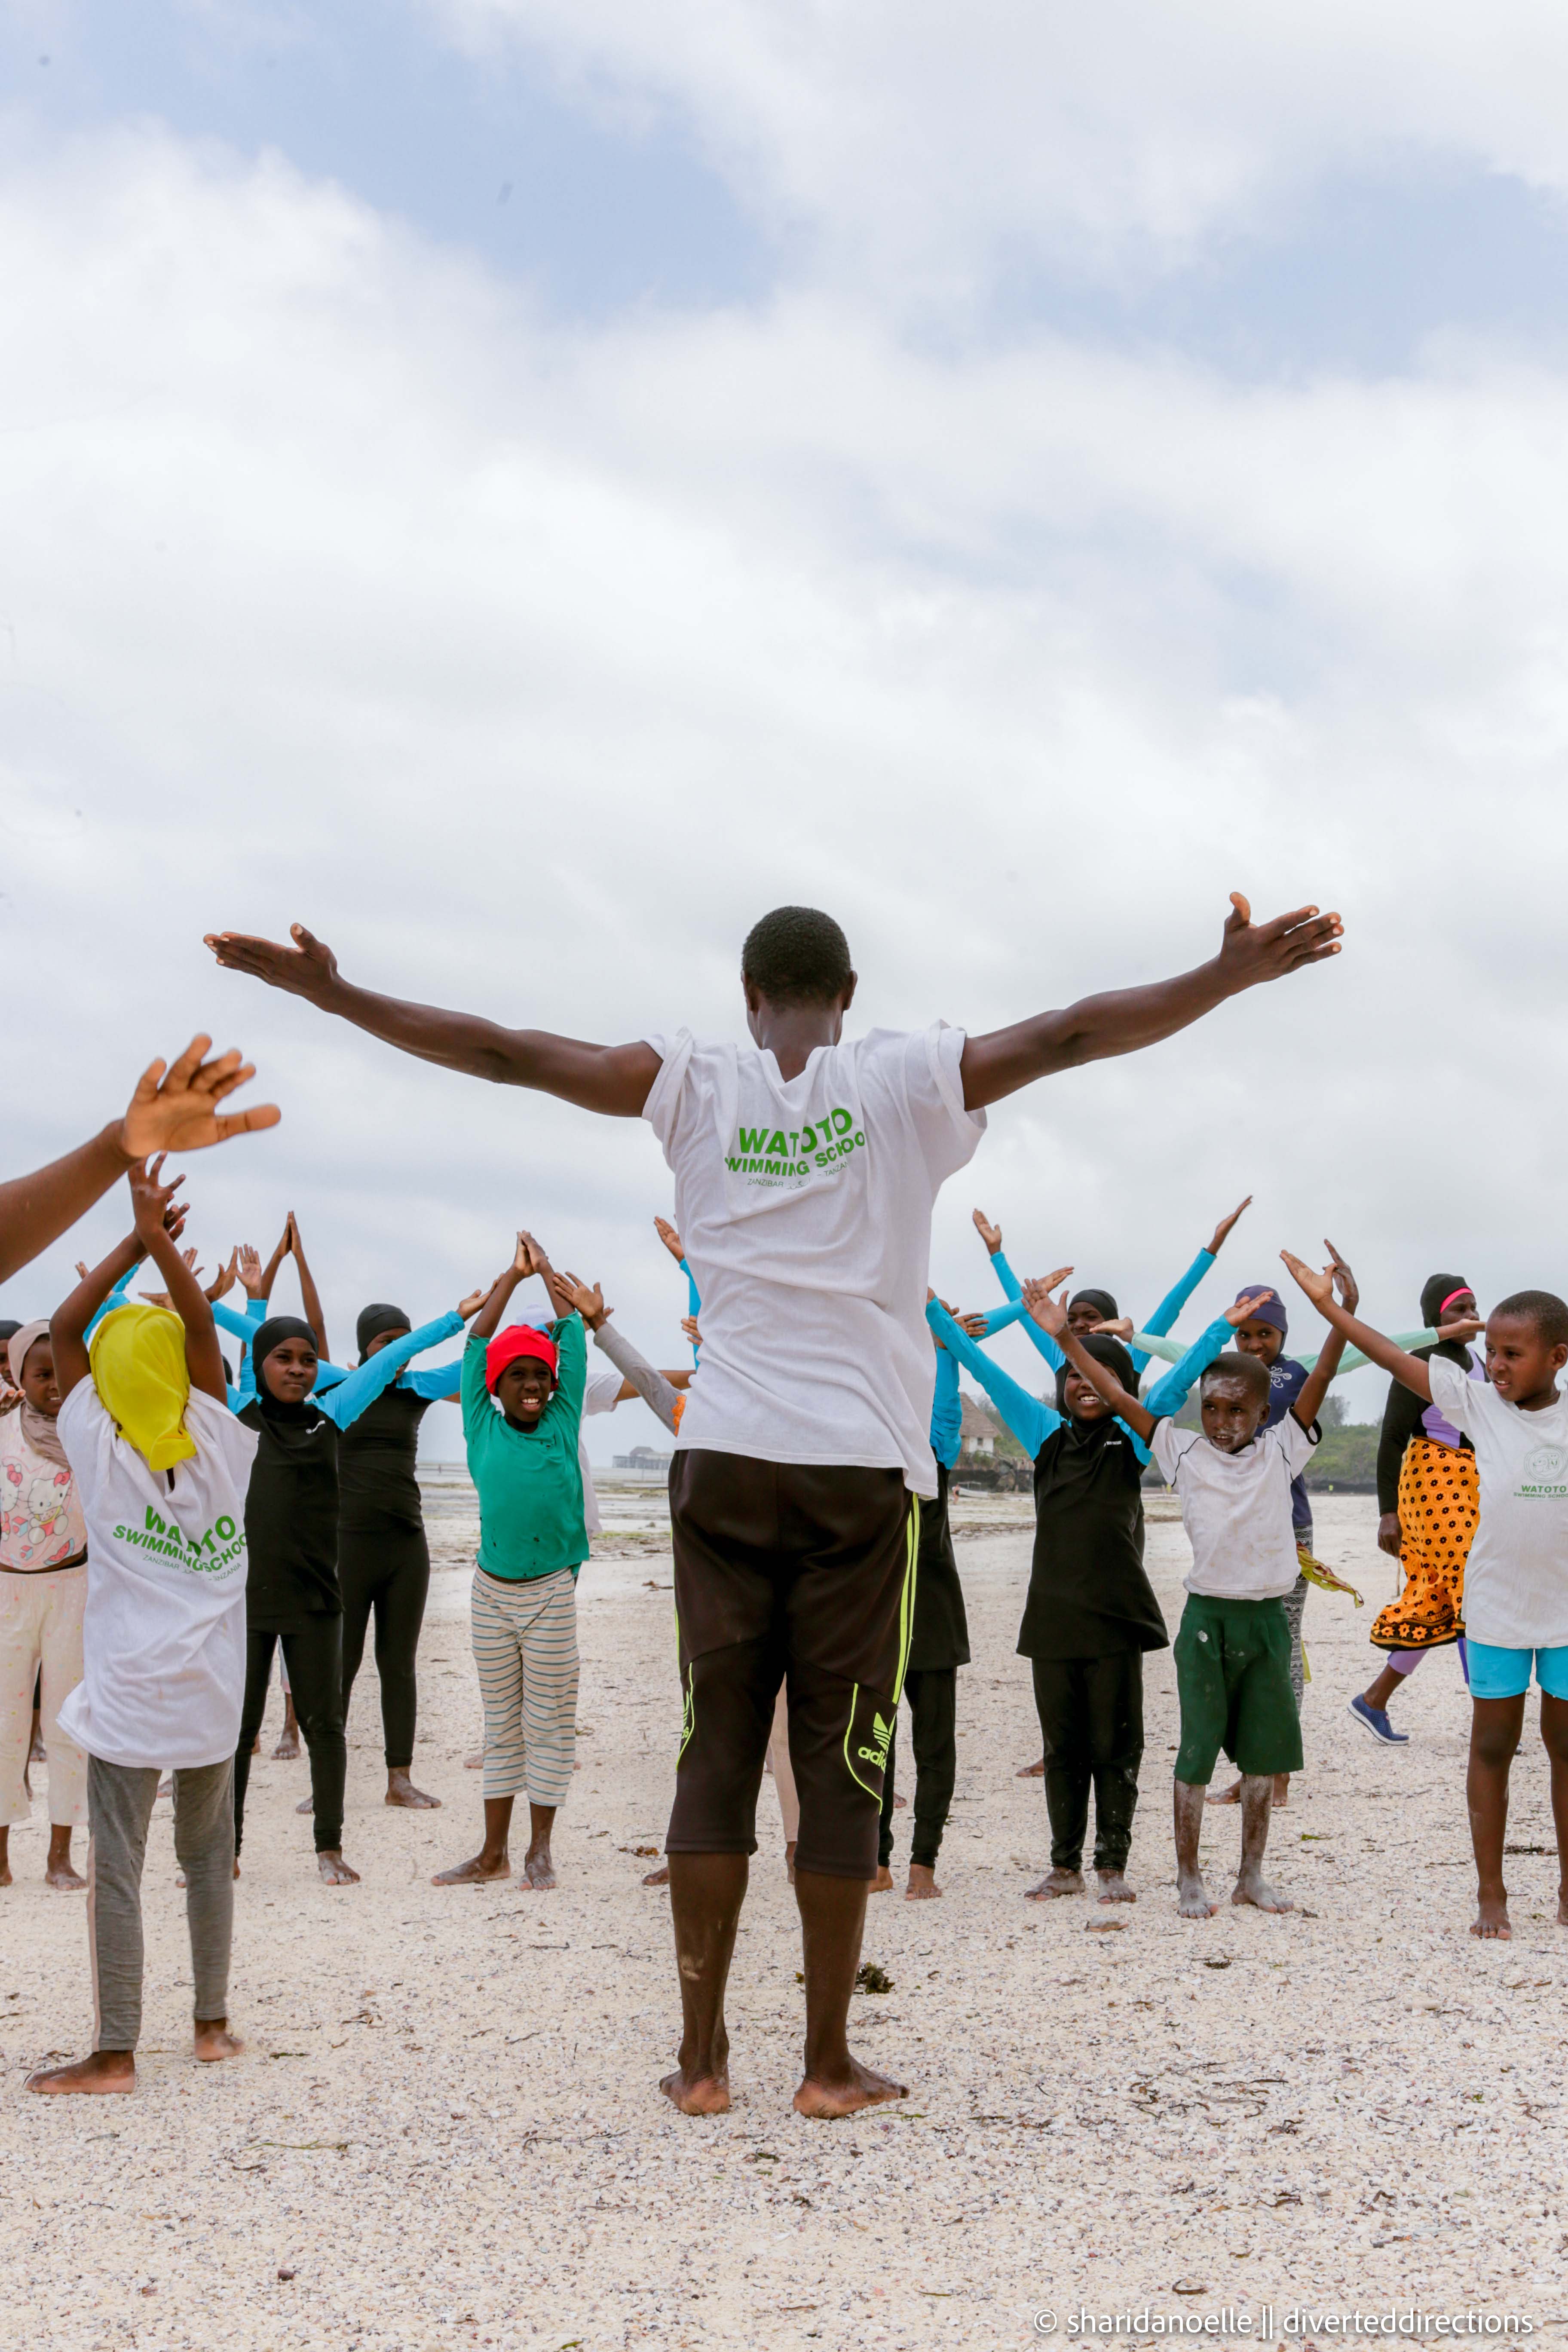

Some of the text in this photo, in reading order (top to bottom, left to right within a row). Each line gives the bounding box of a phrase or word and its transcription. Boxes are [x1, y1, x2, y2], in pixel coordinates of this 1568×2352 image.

[724, 1131, 865, 1176] WIMMING SCHOO
[739, 1108, 853, 1158] WATOTO
[747, 1178, 784, 1187] ZANZIBAR
[824, 1161, 850, 1176] TANZAN
[113, 1525, 247, 1572] SWIMMING SCHOO
[143, 1554, 180, 1570] ZANZIBAR
